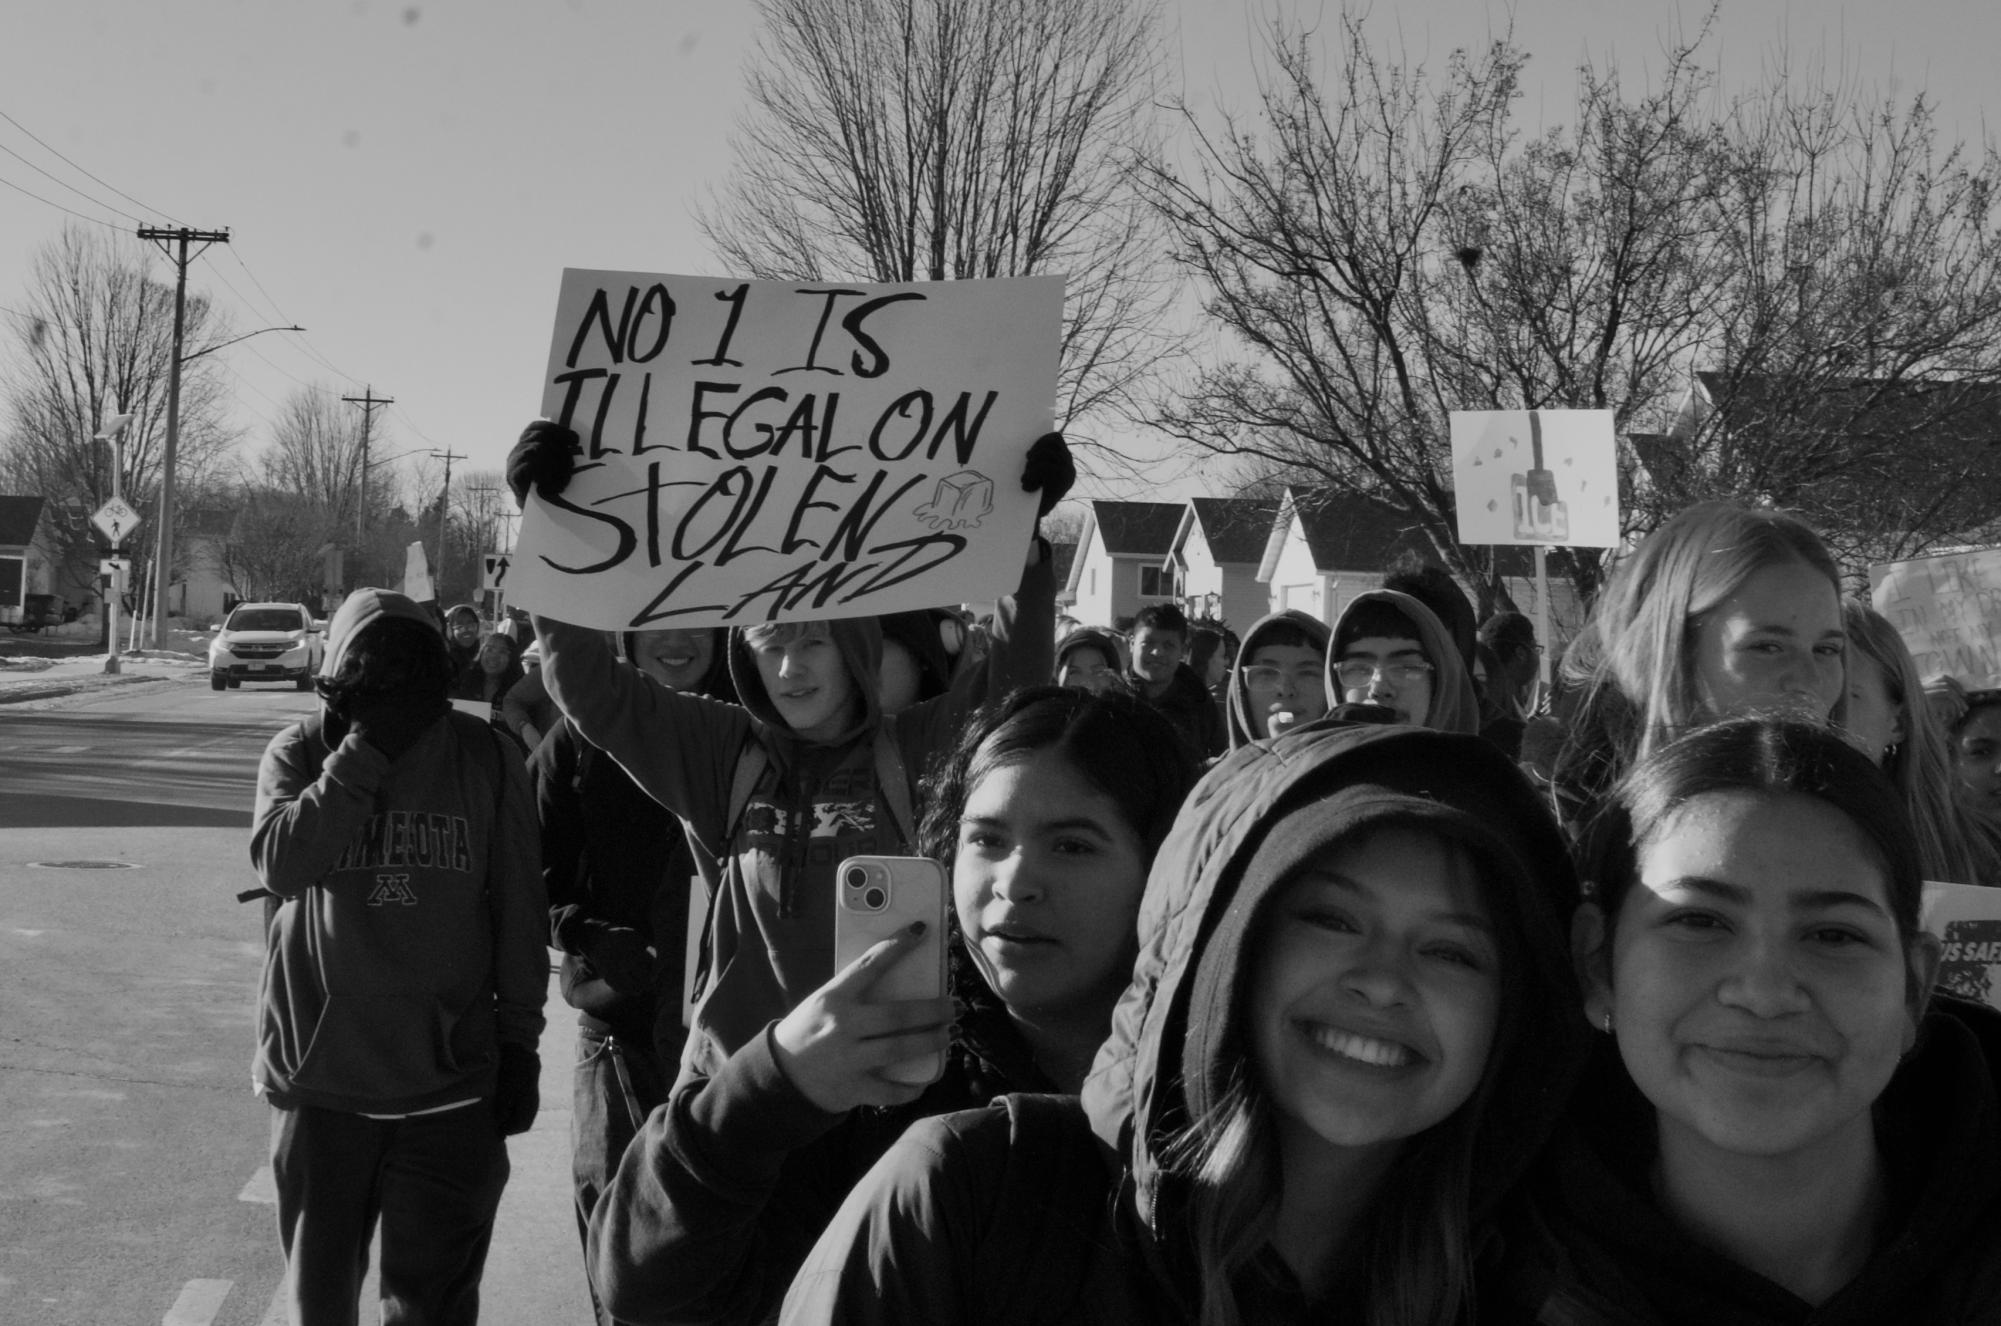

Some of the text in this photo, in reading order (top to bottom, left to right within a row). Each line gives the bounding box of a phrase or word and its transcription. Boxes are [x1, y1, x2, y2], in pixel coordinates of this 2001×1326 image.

[565, 283, 927, 378] NO 1 IS
[554, 367, 998, 467] ILLEGAL ON
[537, 462, 928, 575] STOLEN
[629, 530, 968, 628] LAND
